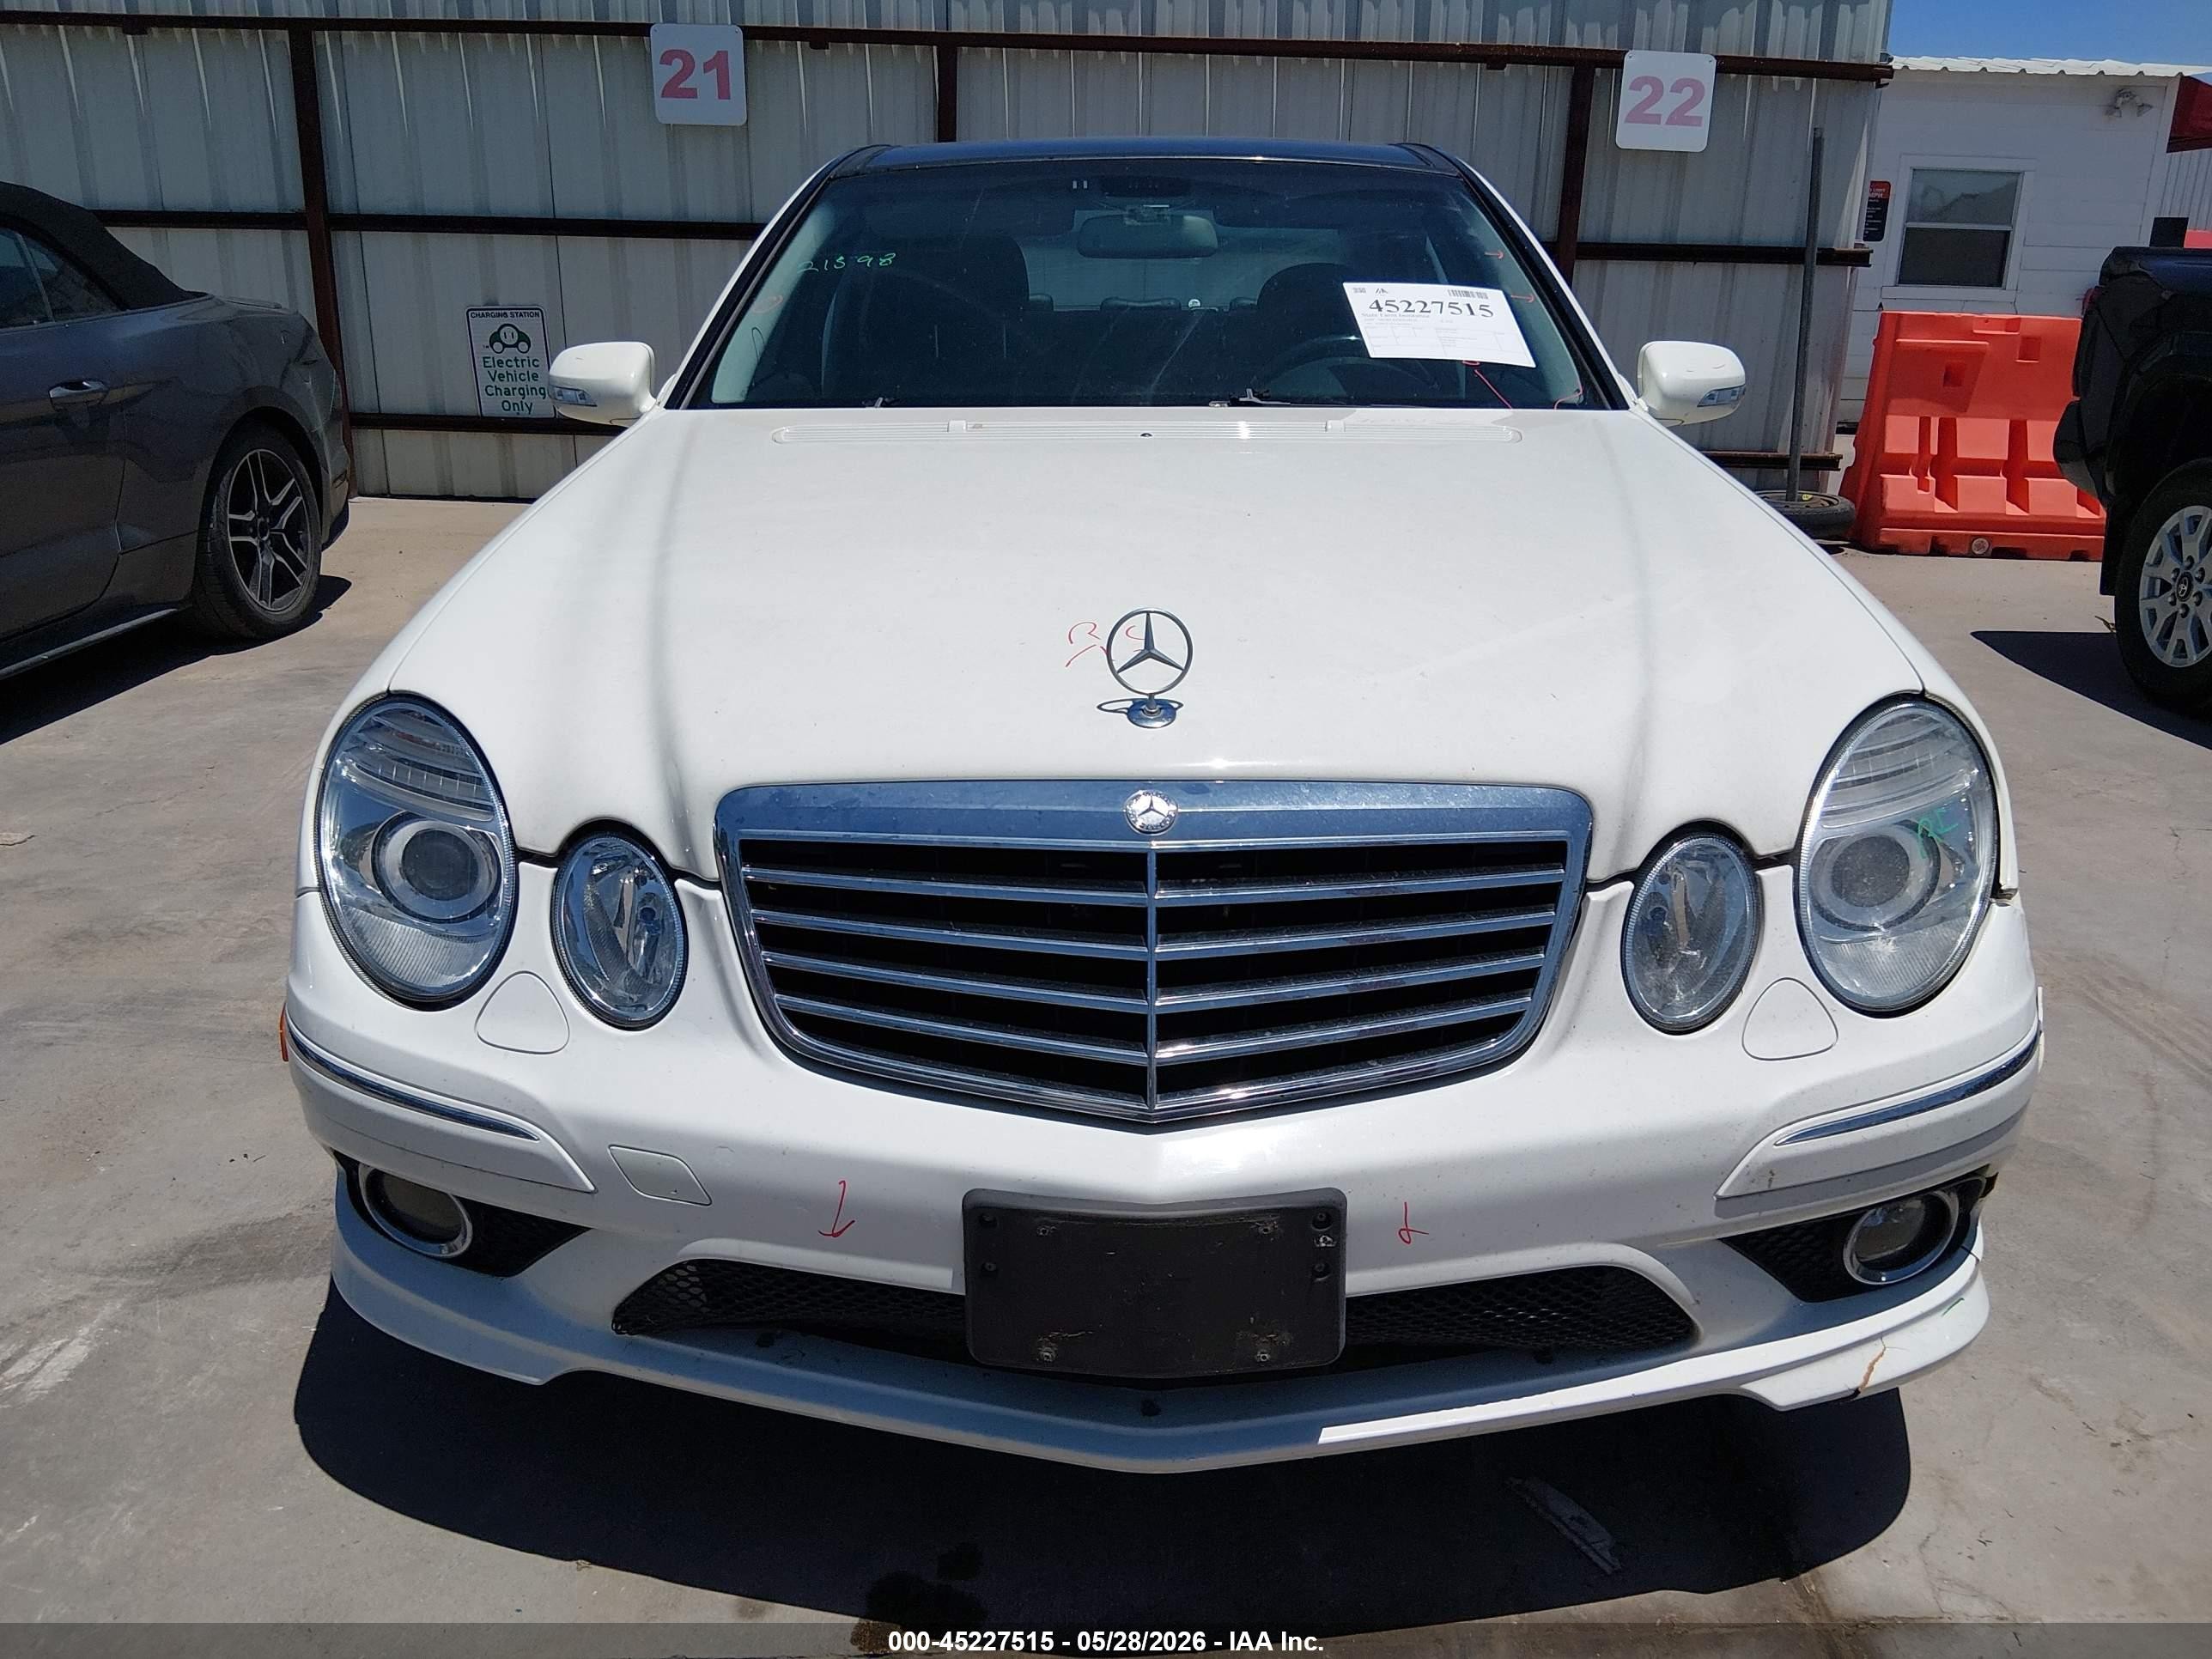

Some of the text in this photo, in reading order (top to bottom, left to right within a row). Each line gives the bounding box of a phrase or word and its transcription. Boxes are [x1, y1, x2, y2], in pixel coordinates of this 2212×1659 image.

[659, 49, 731, 100] 21
[1624, 76, 1705, 127] 22
[1369, 299, 1494, 318] 45227515
[483, 356, 539, 368] Electric
[488, 370, 539, 382] Vehicle
[484, 385, 547, 399] Charging
[501, 399, 533, 414] Only
